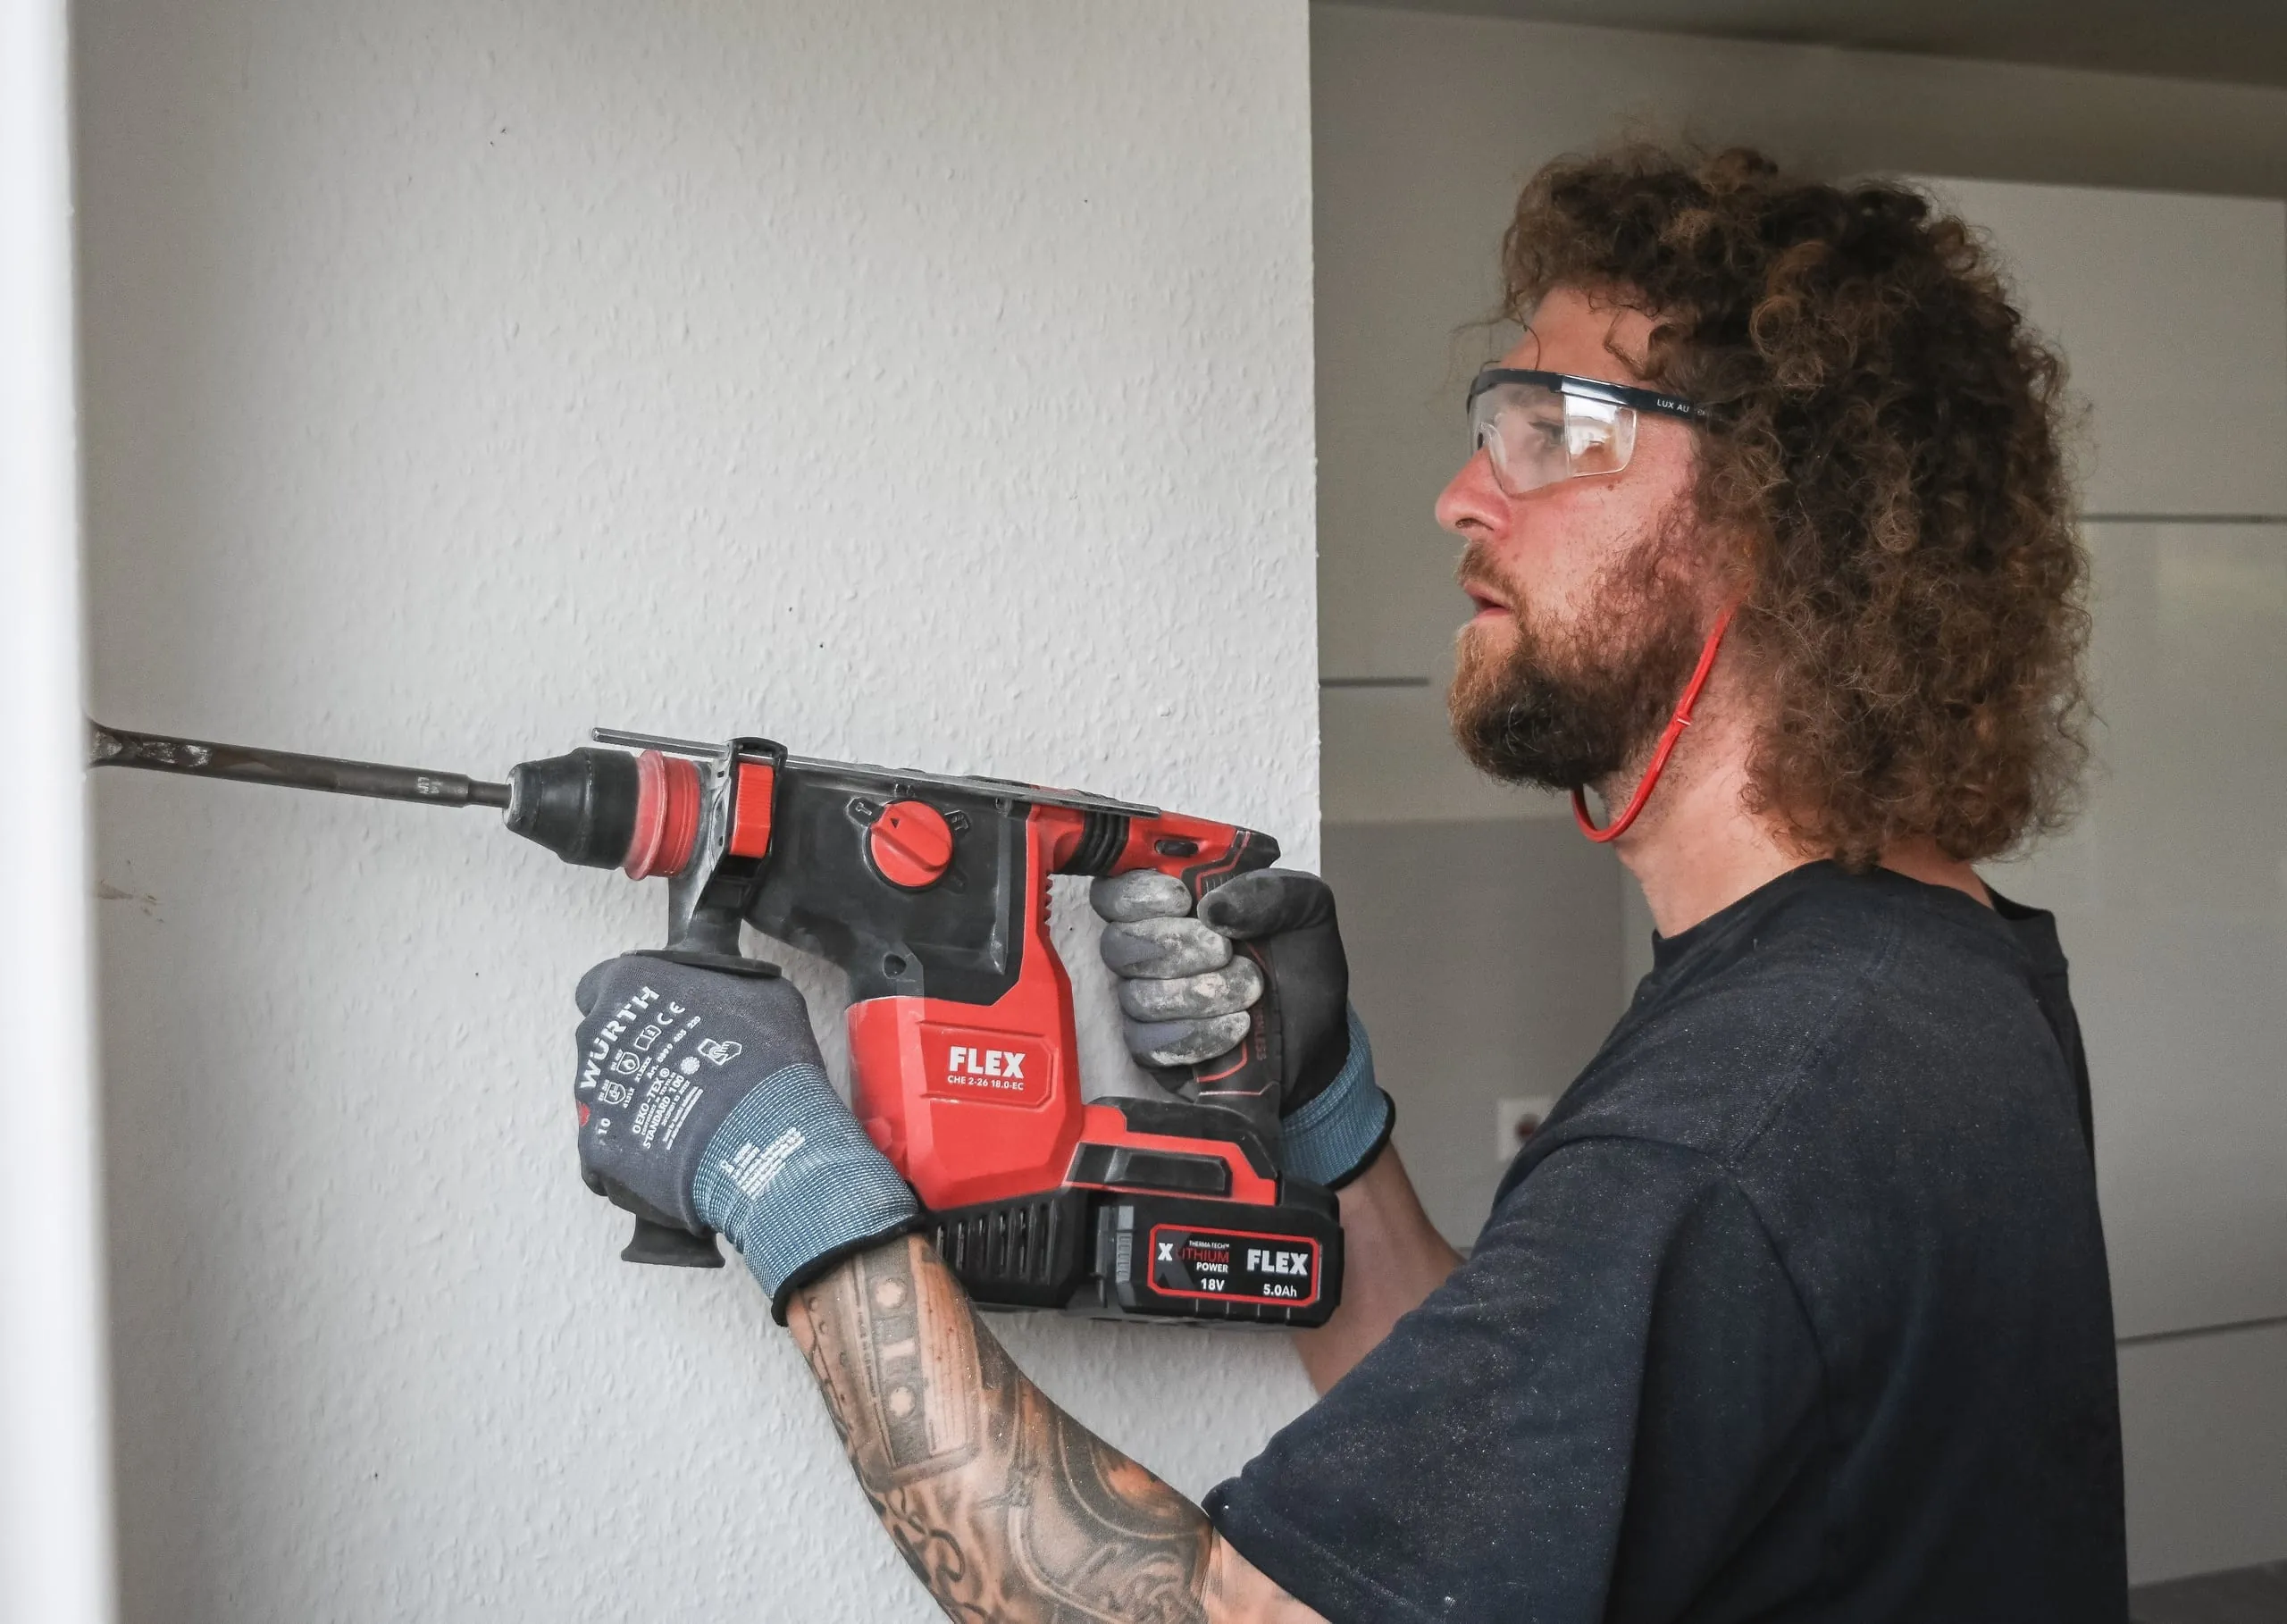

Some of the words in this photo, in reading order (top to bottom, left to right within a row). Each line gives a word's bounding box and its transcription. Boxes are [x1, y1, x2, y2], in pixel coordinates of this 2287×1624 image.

[1656, 398, 1674, 409] LUX
[581, 985, 660, 1089] WÜRTH
[950, 1046, 1026, 1079] FLEX
[948, 1076, 967, 1084] CHE
[968, 1077, 988, 1086] 2-26
[992, 1080, 1024, 1091] 18.0-EC
[643, 1095, 671, 1149] STANDARD
[668, 1075, 685, 1094] 100
[597, 1117, 612, 1134] 10
[1196, 1261, 1228, 1273] POWER
[1246, 1249, 1309, 1276] FLEX
[1201, 1278, 1225, 1291] 18V
[1263, 1285, 1297, 1297] 5.0Ah
